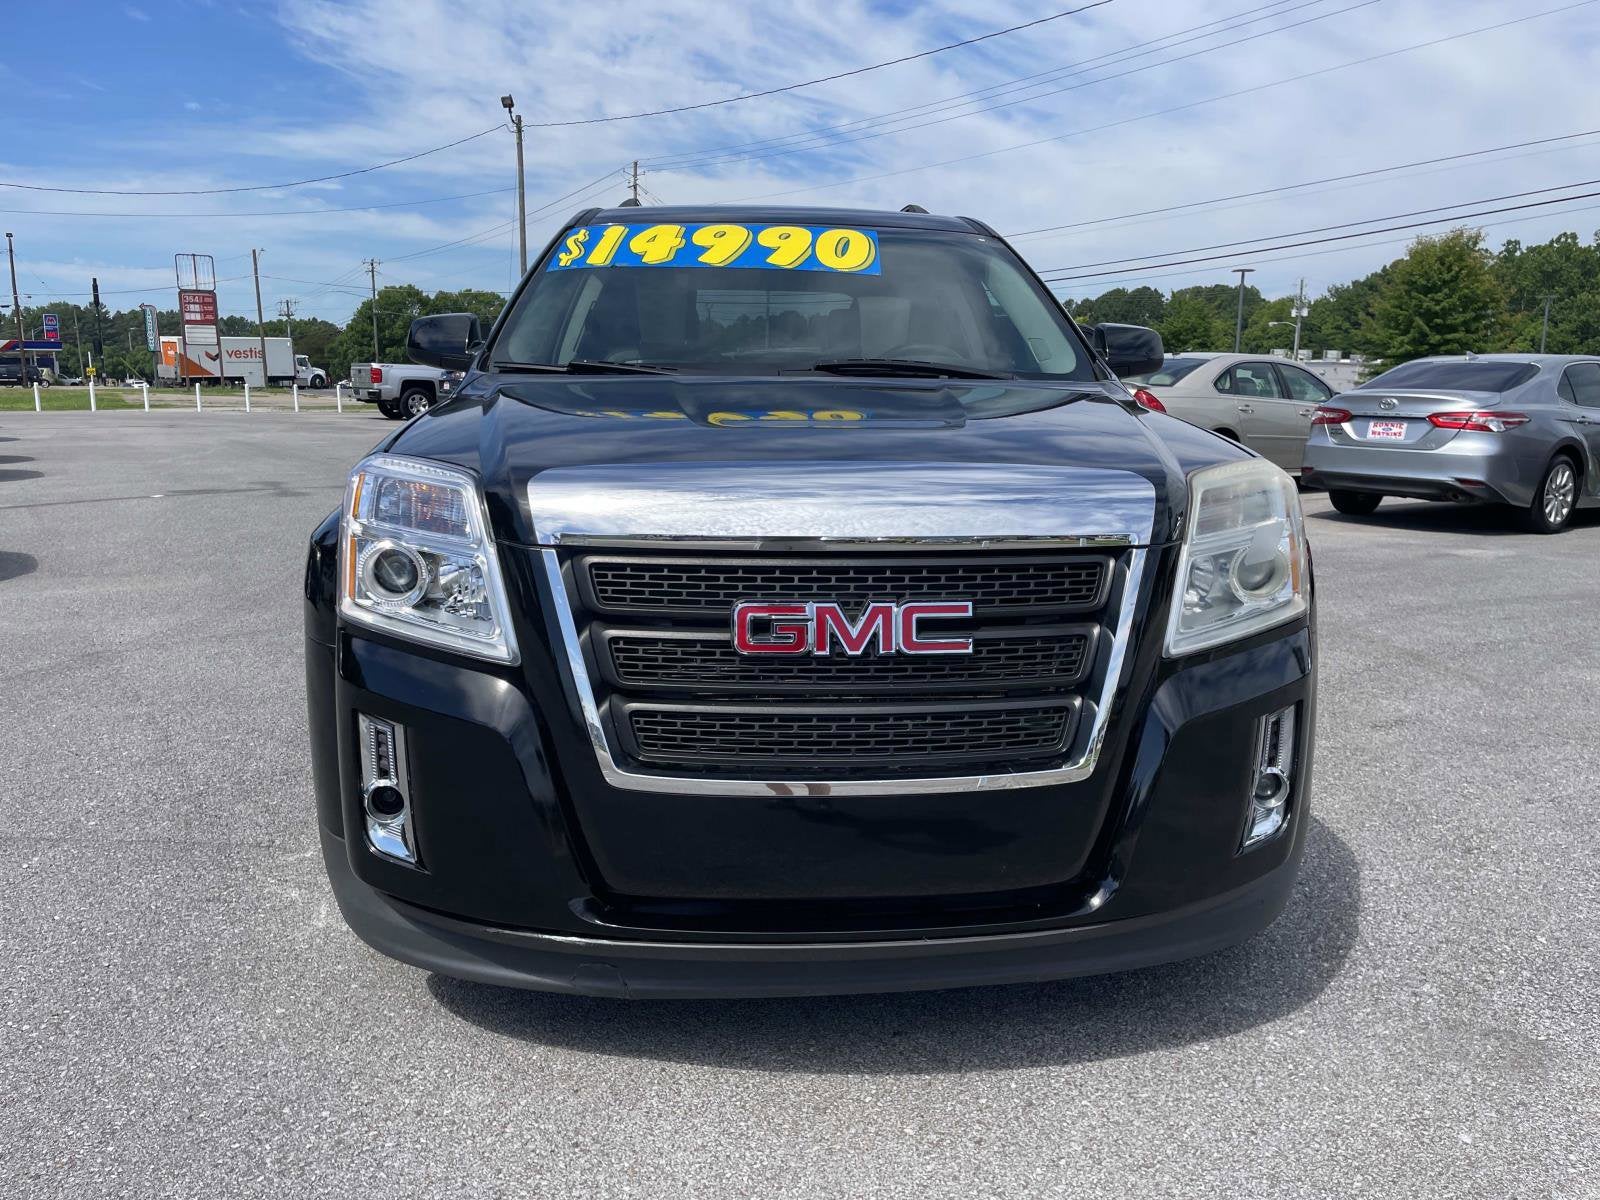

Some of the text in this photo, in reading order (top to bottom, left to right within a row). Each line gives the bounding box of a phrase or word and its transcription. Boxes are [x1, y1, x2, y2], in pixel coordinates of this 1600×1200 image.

[558, 224, 876, 272] $14990
[226, 347, 264, 359] vestis
[733, 601, 973, 655] GMC
